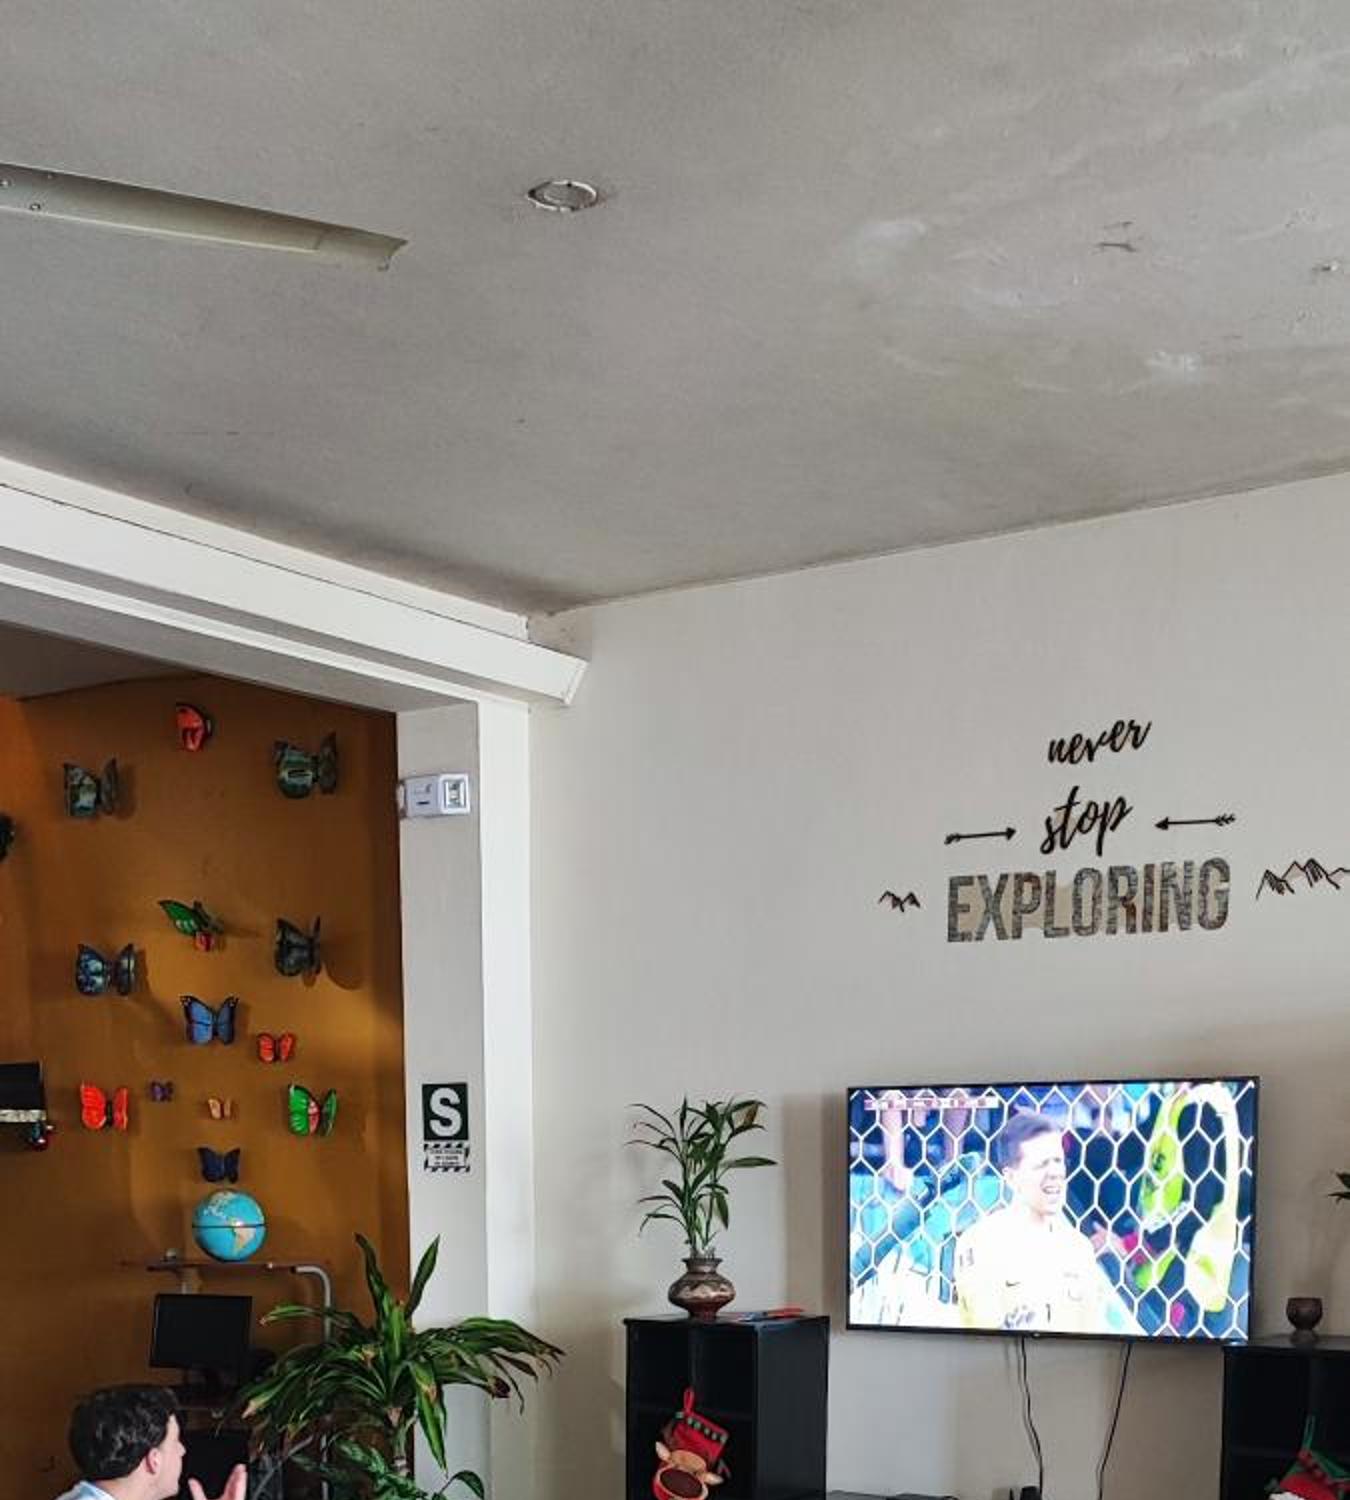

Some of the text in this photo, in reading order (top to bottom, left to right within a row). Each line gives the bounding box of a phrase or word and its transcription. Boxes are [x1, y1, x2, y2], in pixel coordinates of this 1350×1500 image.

[1047, 718, 1152, 764] never
[1039, 785, 1133, 856] stop
[946, 857, 1231, 942] EXPLORING
[429, 1087, 462, 1137] S
